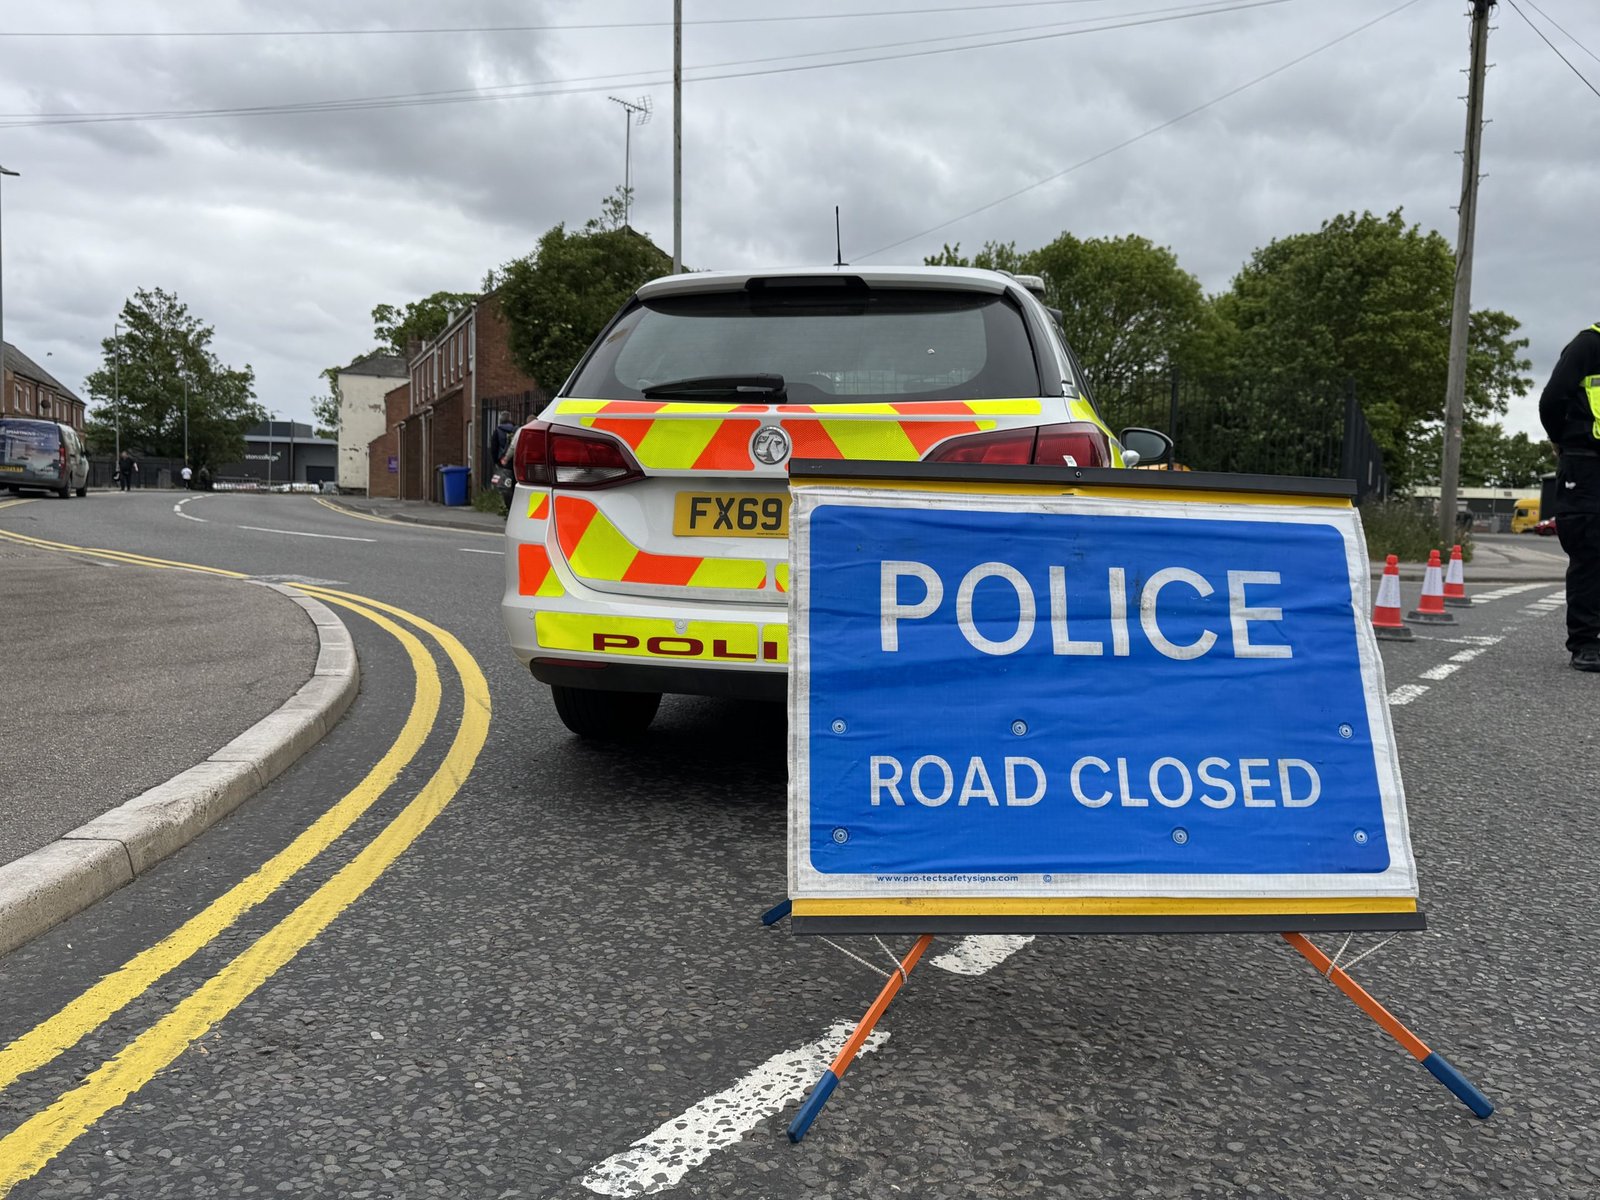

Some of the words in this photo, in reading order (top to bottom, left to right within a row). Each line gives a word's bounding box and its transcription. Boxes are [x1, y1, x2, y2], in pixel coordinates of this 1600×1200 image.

[689, 496, 783, 531] FX69
[880, 560, 1293, 660] POLICE
[592, 633, 778, 660] POLI
[870, 754, 1047, 808] ROAD
[1070, 756, 1321, 809] CLOSED
[876, 873, 1019, 884] www.pro-tectsafetysigns.com
